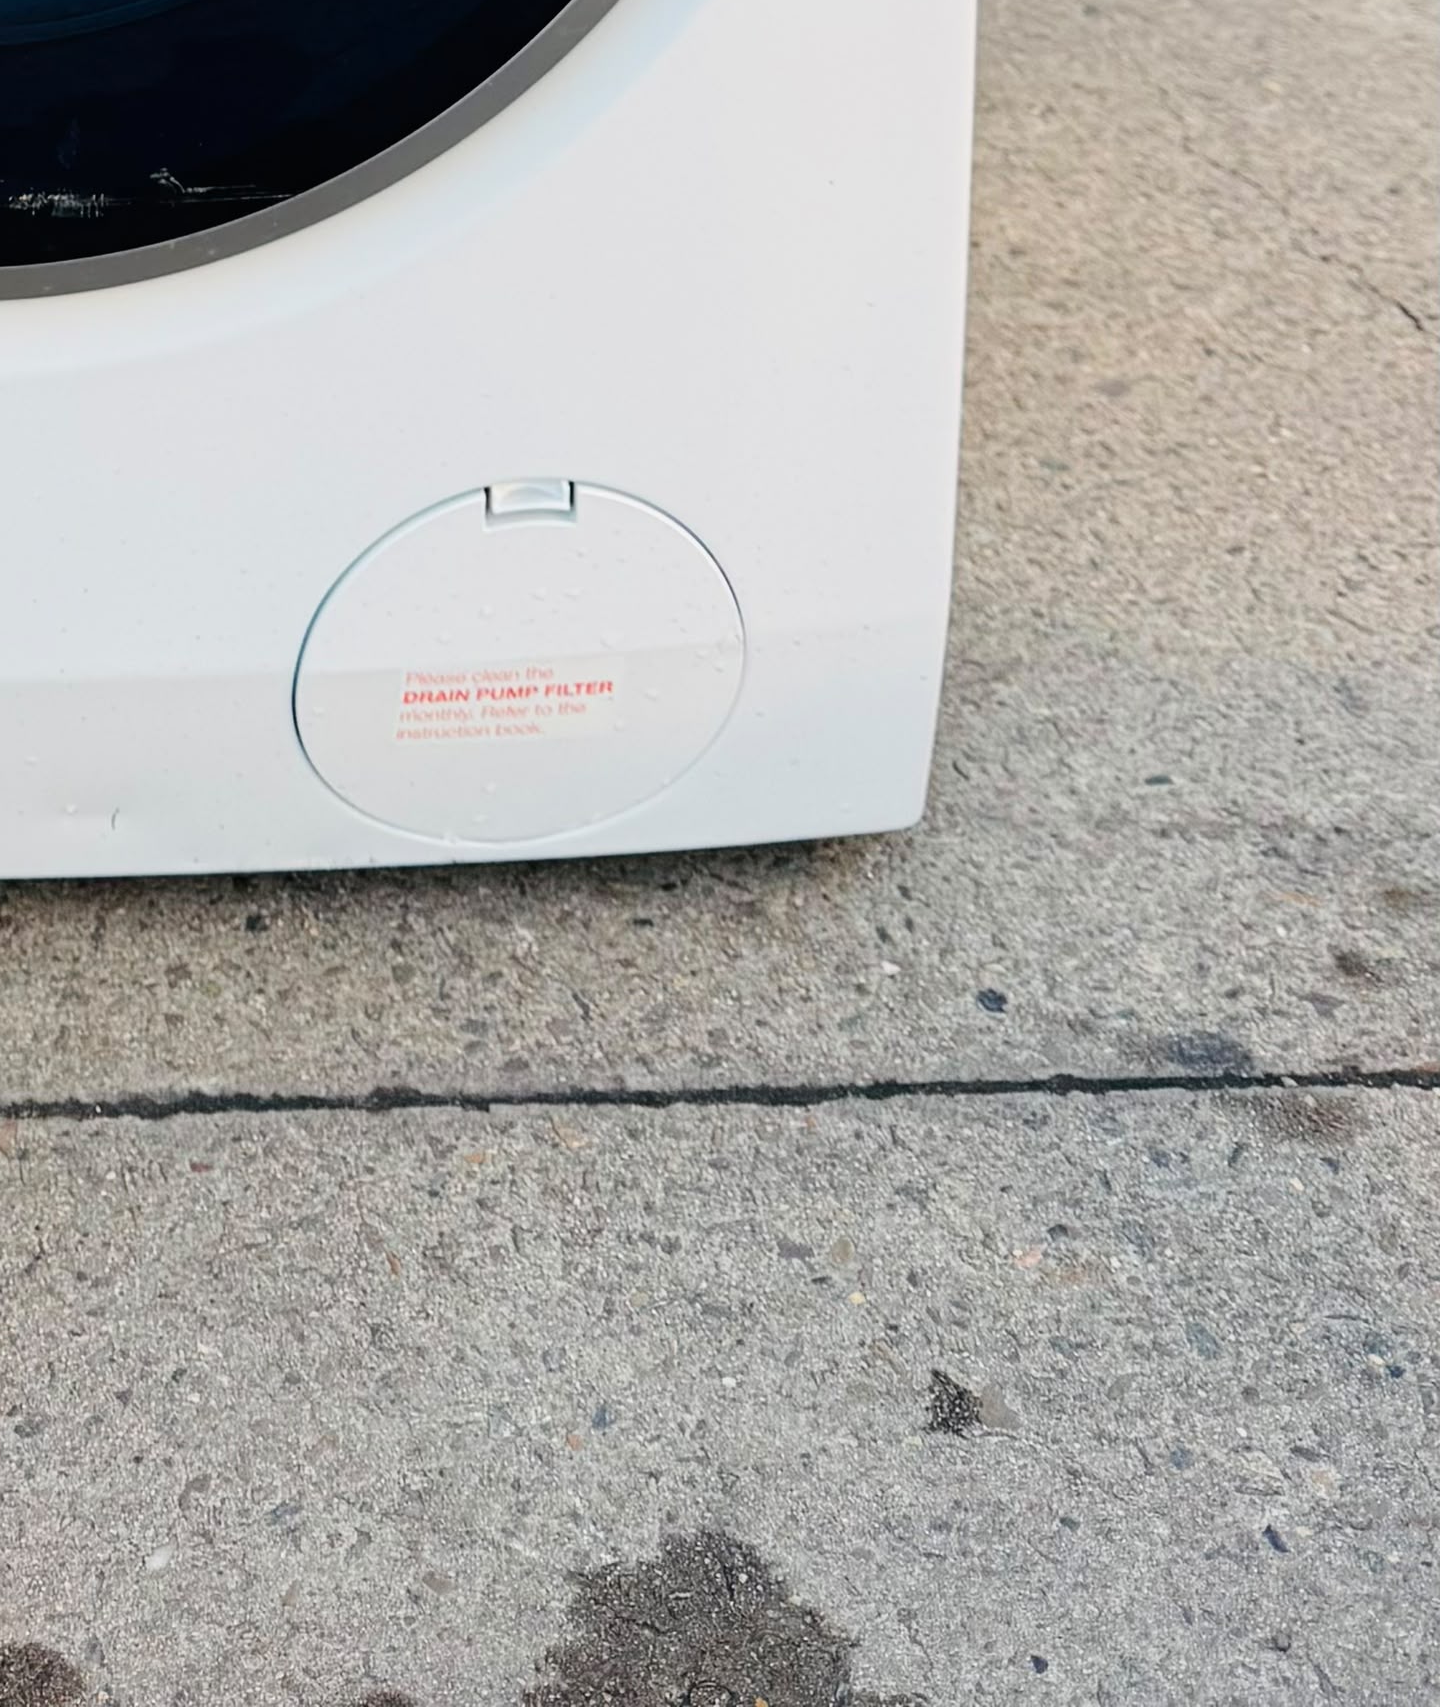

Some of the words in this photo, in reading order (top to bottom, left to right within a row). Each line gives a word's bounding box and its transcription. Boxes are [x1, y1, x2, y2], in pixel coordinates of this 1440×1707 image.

[406, 670, 466, 685] Please
[471, 669, 520, 683] clean
[525, 666, 555, 681] the
[402, 690, 470, 705] DRAIN
[475, 685, 538, 701] PUMP
[544, 680, 614, 698] FILTER
[399, 707, 474, 724] monthly.
[480, 704, 529, 720] Refer
[534, 703, 553, 716] to
[558, 701, 587, 715] the
[396, 725, 491, 740] instruction
[495, 722, 544, 737] book.
